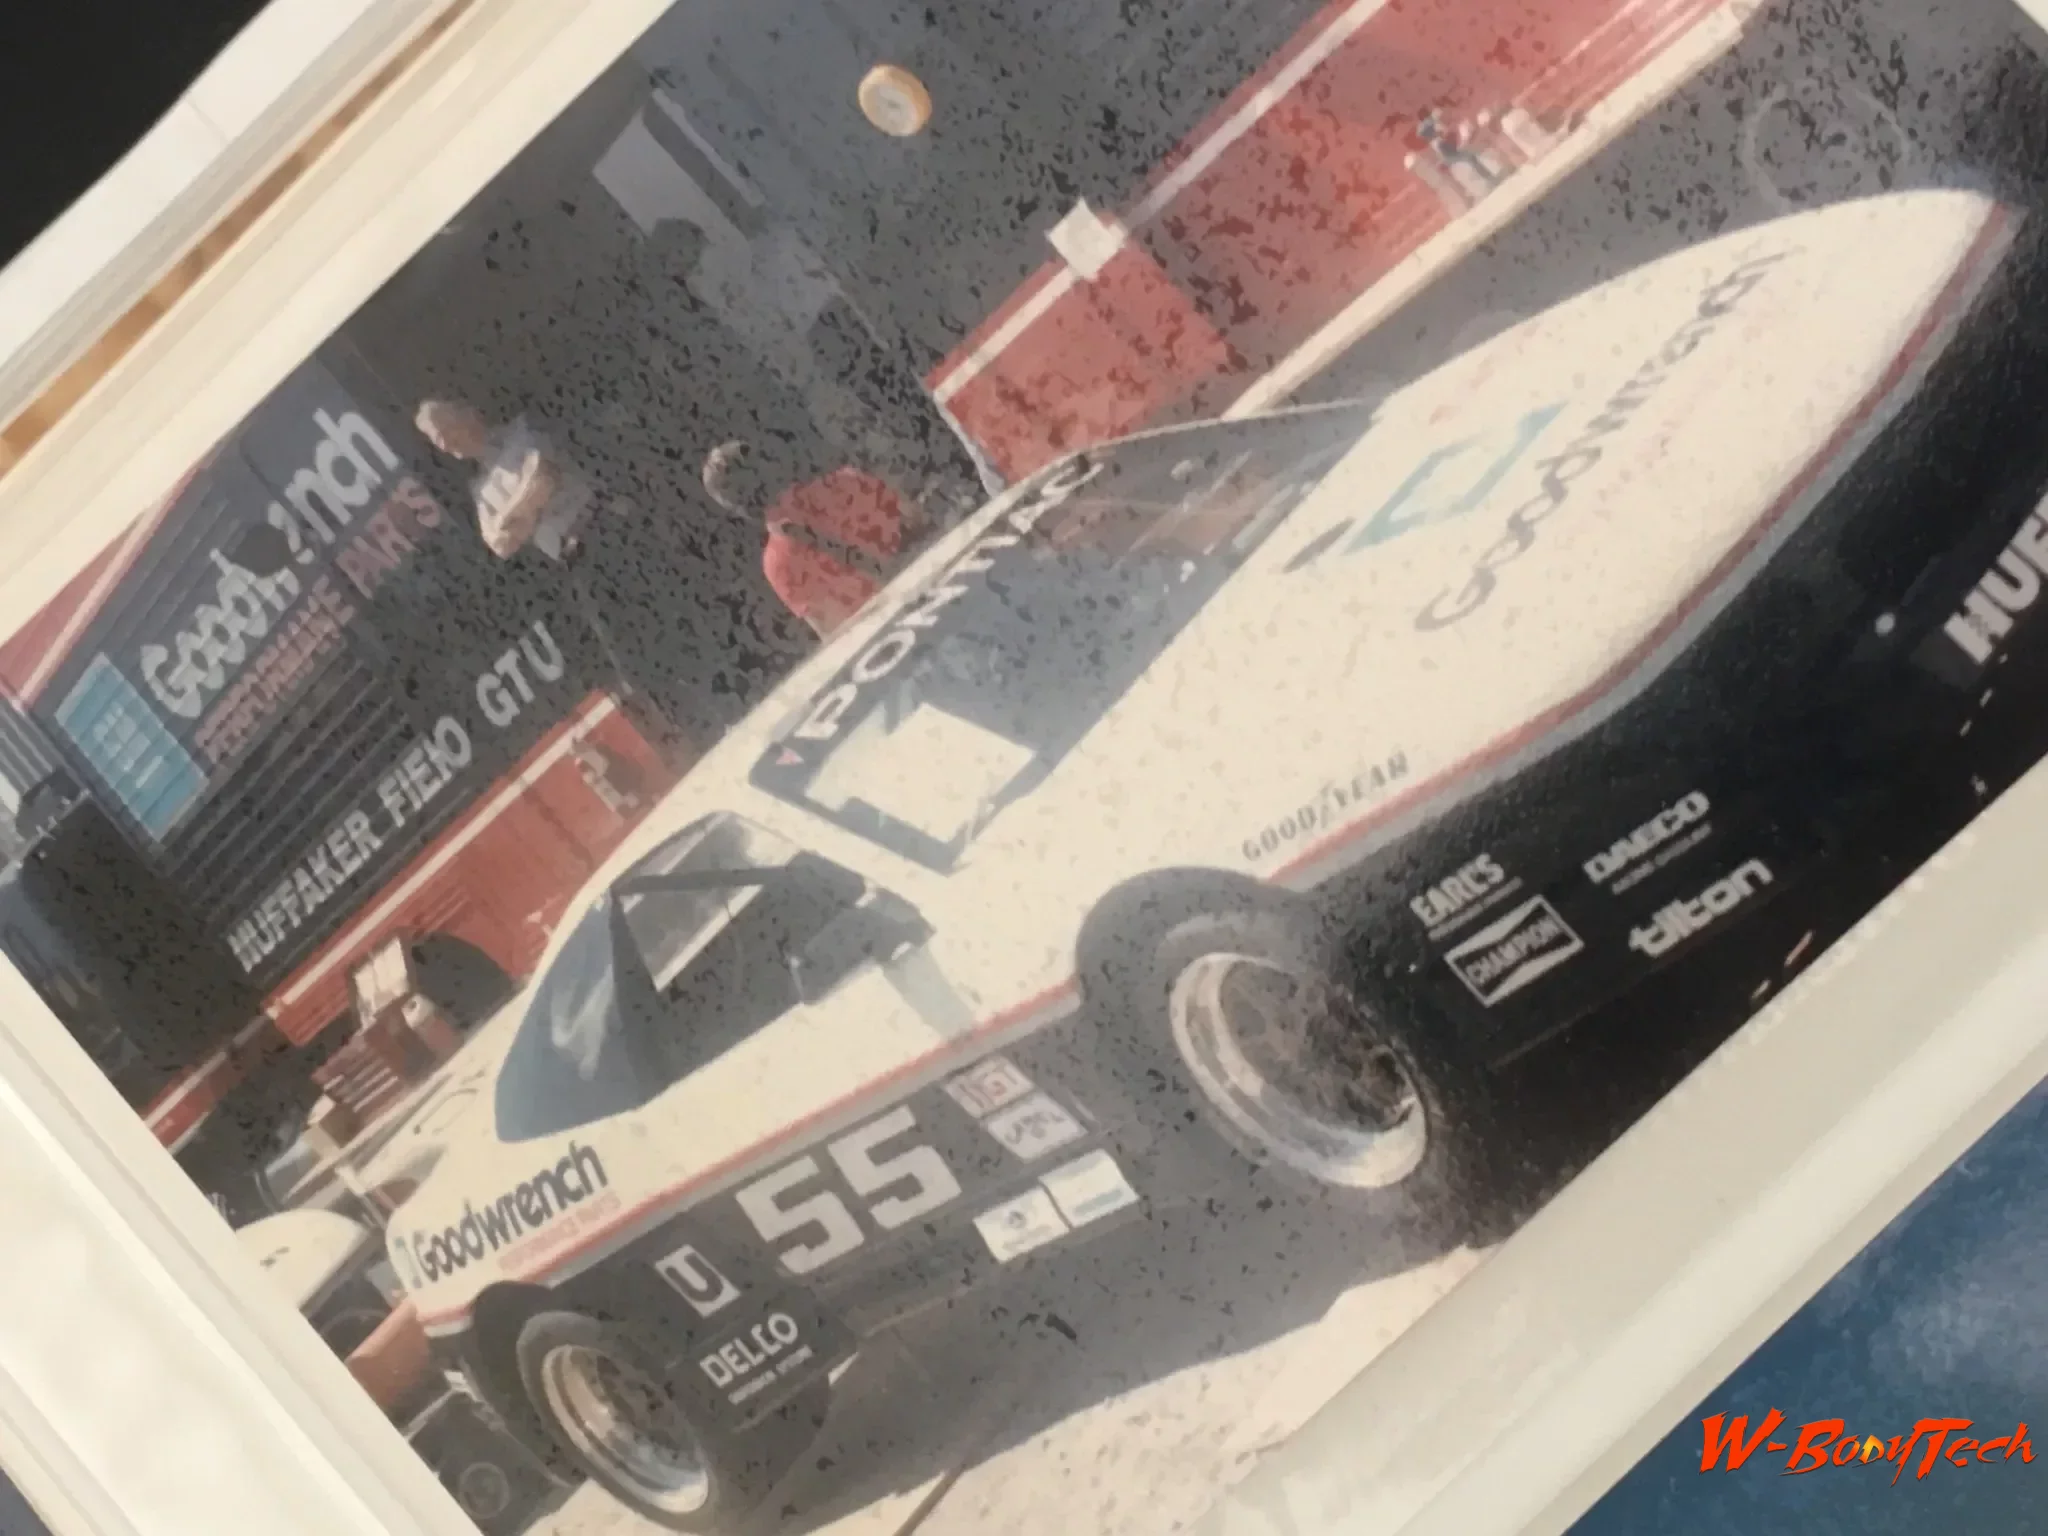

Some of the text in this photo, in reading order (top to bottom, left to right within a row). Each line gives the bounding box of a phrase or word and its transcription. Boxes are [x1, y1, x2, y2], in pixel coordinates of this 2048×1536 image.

[140, 407, 400, 718] Goodwench
[793, 462, 1105, 740] PONTIAC
[227, 808, 383, 973] HUFFAKER
[476, 619, 565, 727] GTU
[1465, 916, 1562, 986] CHAMPION
[1628, 857, 1774, 959] tilton
[413, 1140, 608, 1283] Goodwrench
[735, 1104, 963, 1275] 55
[699, 1311, 799, 1388] DELCO
